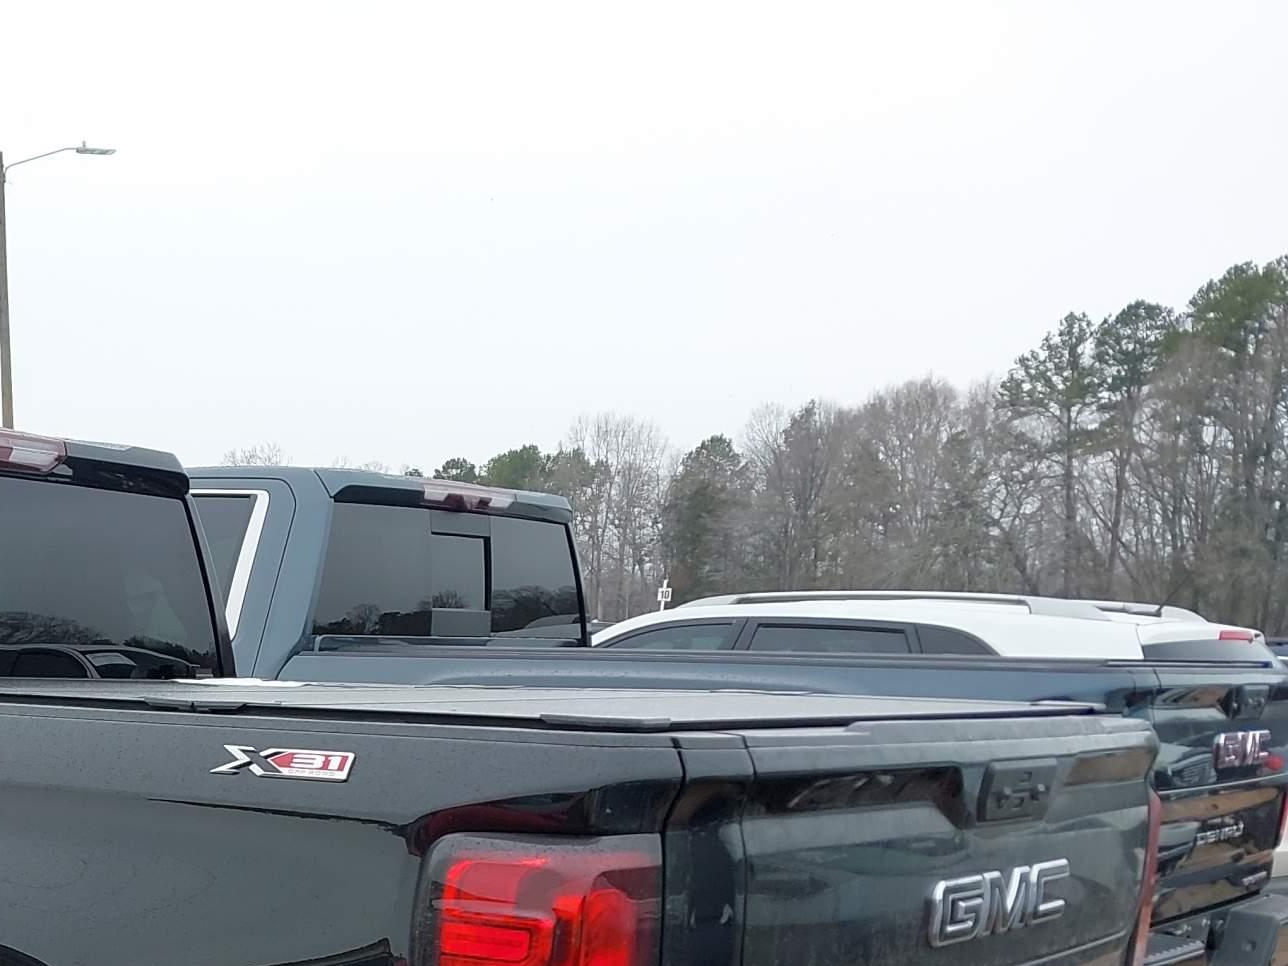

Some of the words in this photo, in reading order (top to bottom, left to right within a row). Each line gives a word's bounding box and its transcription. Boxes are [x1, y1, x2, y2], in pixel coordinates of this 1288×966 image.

[209, 744, 355, 781] X31
[1214, 730, 1271, 769] GMC
[929, 858, 1070, 948] GMC
